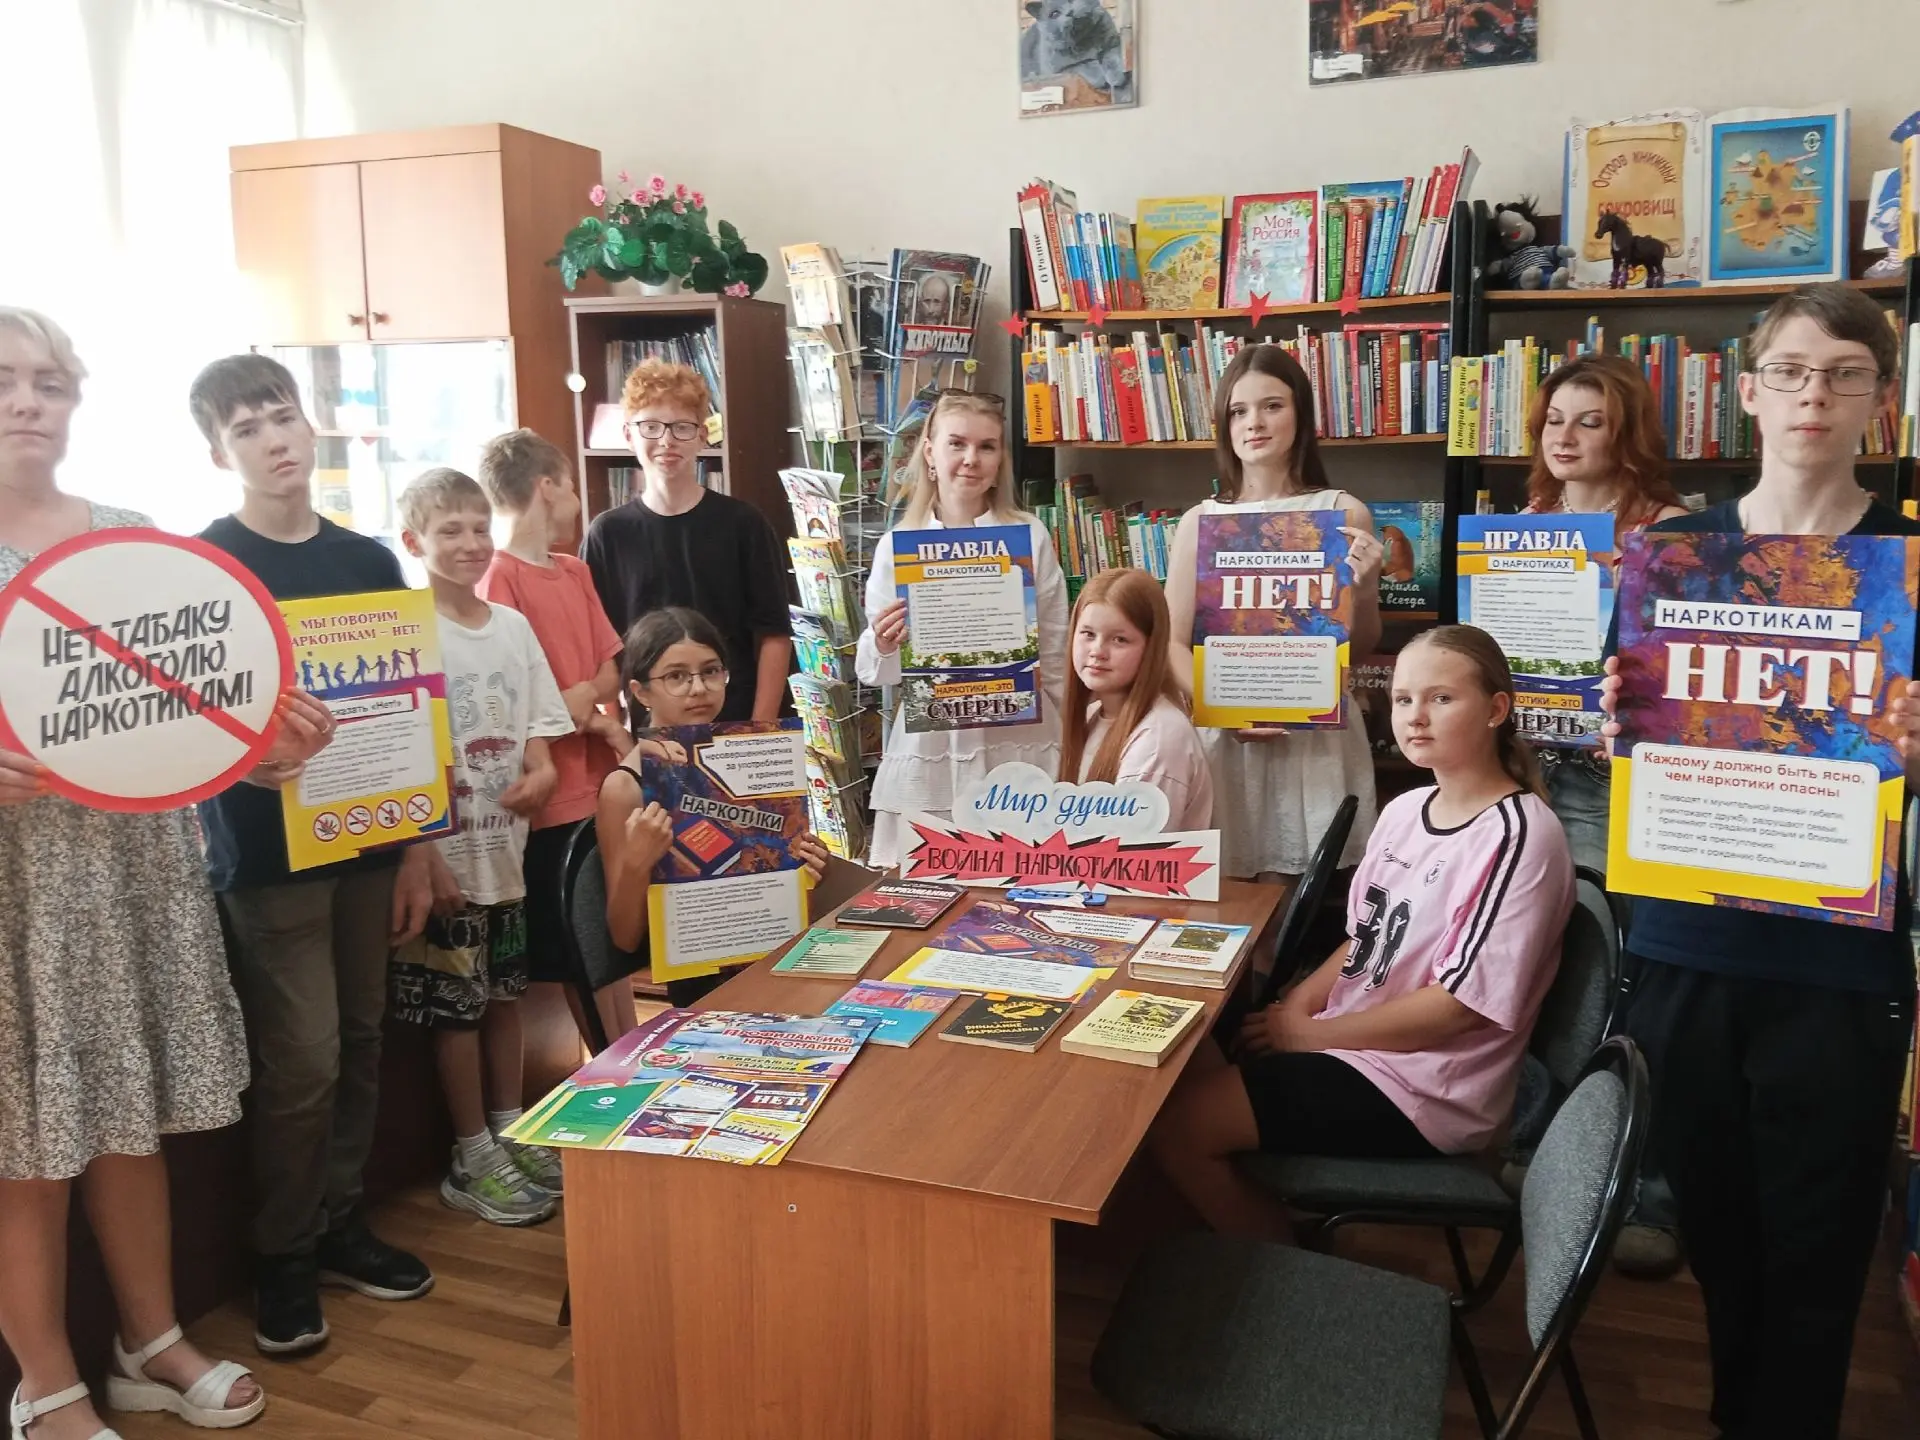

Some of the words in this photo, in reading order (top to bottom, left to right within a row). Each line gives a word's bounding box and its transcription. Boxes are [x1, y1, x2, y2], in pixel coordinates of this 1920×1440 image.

[917, 540, 1011, 561] ПРАВДА
[1483, 530, 1587, 554] ПРАВДА
[1219, 554, 1310, 566] НАРКОТИКАМ
[1493, 560, 1499, 568] О
[1502, 560, 1570, 569] НАРКОТИКАХ
[936, 565, 998, 576] НАРКОТИКАХ
[1219, 574, 1334, 610] НЕТ!
[301, 618, 326, 630] МЫ
[331, 611, 398, 627] ГОВОРИМ
[1662, 608, 1833, 631] НАРКОТИКАМ
[292, 629, 376, 647] АРКОТИКАМ
[392, 624, 421, 636] НЕТ!
[42, 625, 102, 668] НЕТ
[936, 684, 988, 695] НАРКОТИКИ
[996, 682, 1014, 691] ЭТО
[1662, 642, 1877, 715] НЕТ!
[41, 670, 253, 749] НАРКОТИКАМ!
[927, 698, 1019, 720] СМЕРТЬ
[1561, 698, 1581, 708] ЭТО
[1515, 713, 1586, 737] ЕРТЬ
[724, 737, 792, 747] Ответственность
[705, 748, 793, 760] несовершеннолетних
[738, 759, 793, 771] употребление
[755, 770, 794, 779] хранение
[1644, 752, 1710, 770] Каждому
[1714, 762, 1772, 774] должно
[1777, 764, 1818, 779] быть
[747, 781, 794, 791] наркотиков
[1665, 771, 1692, 782] чем
[1697, 775, 1774, 791] наркотики
[1780, 783, 1840, 797] опасны
[682, 796, 782, 830] НАРКОТИКИ
[975, 784, 1047, 823] Мир
[928, 848, 1003, 873] ВОЙНА
[1016, 851, 1179, 884] НАРКОТИКАМ!
[723, 1028, 855, 1046] ПРОФИЛАКТИКА
[743, 1038, 852, 1053] НАРКОМАНИИ
[803, 1062, 833, 1074] 4
[751, 1095, 808, 1106] НЕТ!
